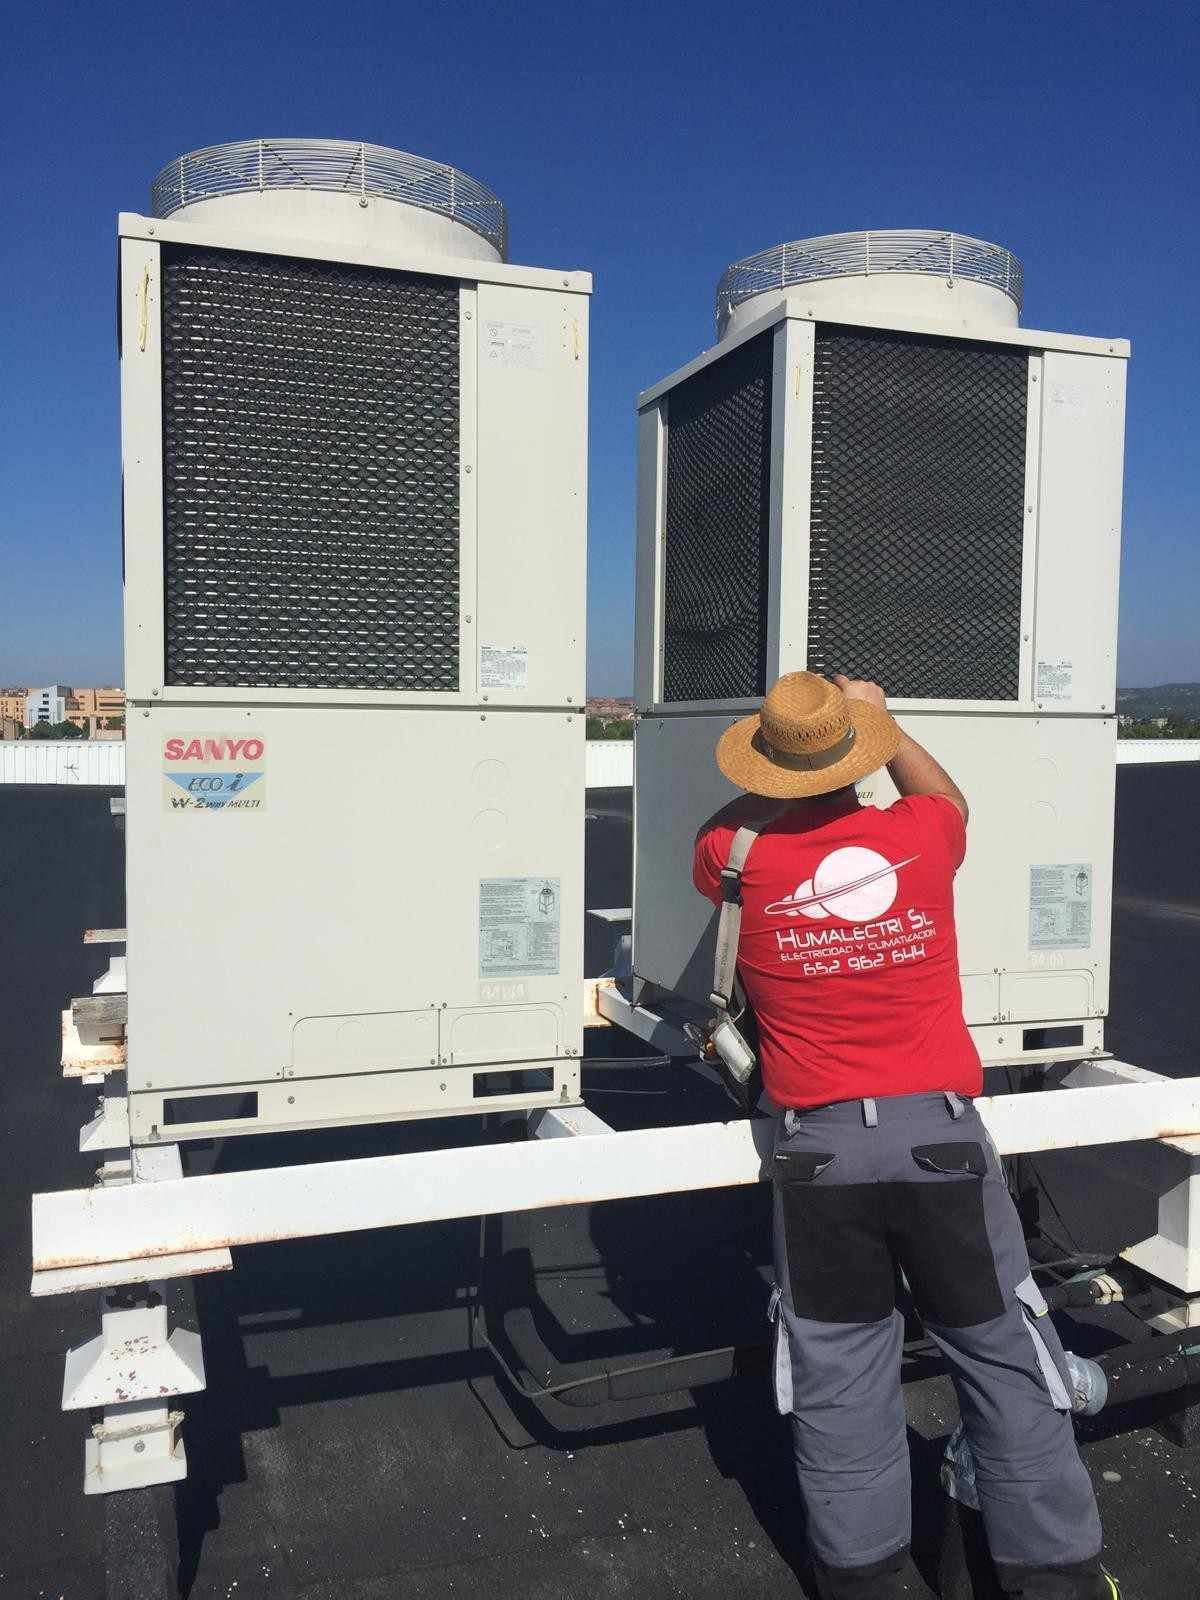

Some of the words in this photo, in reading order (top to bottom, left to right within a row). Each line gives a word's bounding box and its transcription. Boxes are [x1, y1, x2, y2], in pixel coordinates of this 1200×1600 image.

[164, 738, 264, 761] SANYO
[227, 799, 261, 808] MULTI
[780, 945, 854, 962] ELECTRICIDAD
[856, 944, 865, 952] Y
[803, 961, 841, 977] 652
[847, 953, 885, 972] 962
[891, 943, 927, 964] 644
